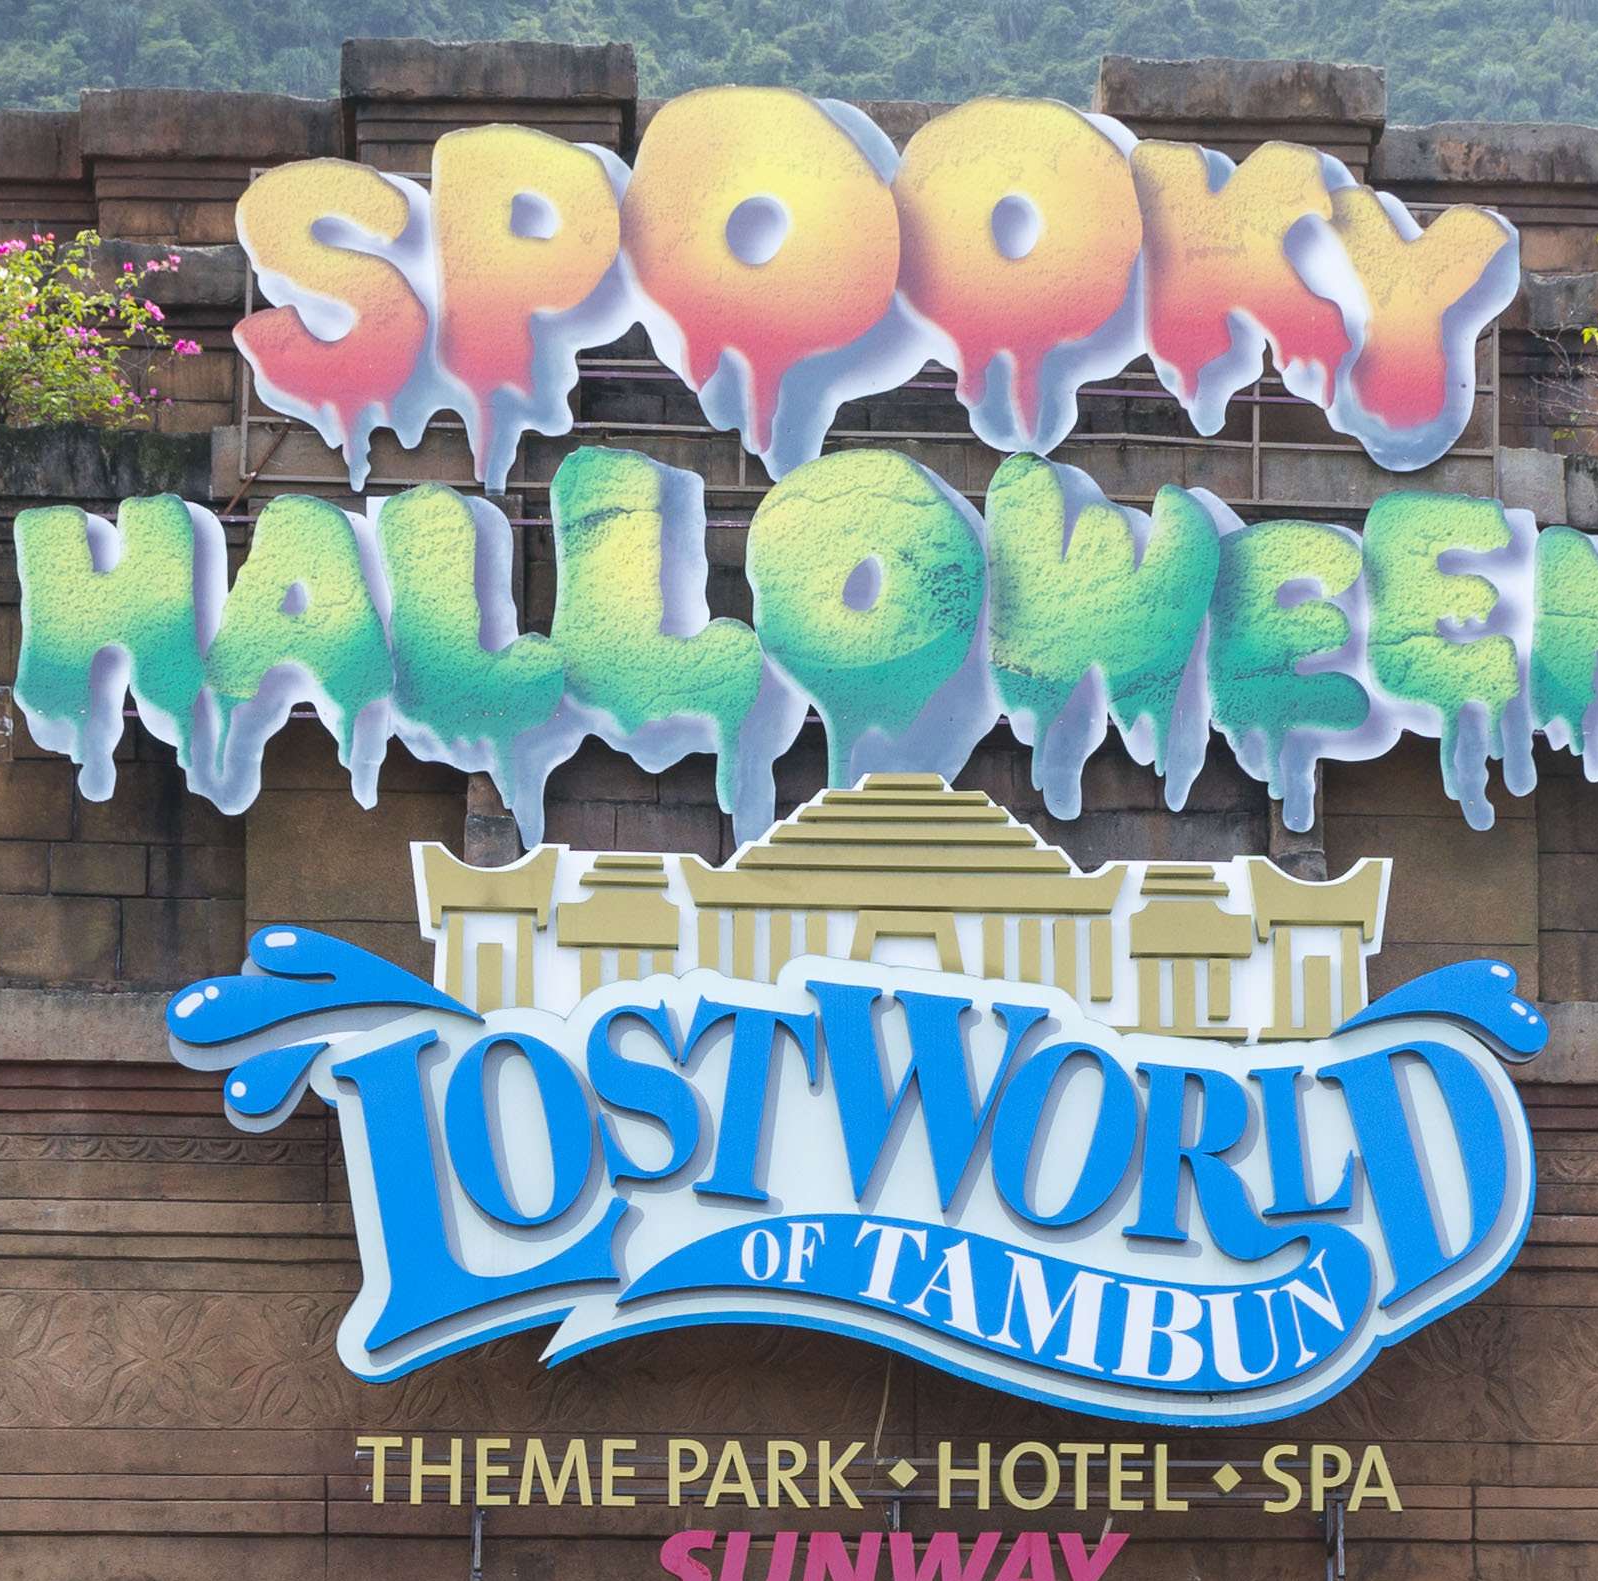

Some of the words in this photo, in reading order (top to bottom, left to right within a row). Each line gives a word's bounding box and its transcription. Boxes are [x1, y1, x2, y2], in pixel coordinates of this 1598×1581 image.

[233, 87, 1521, 492] SPOOKY
[742, 1219, 825, 1285] OF
[853, 1222, 1347, 1385] TAMBUN
[356, 1435, 637, 1508] THEME
[669, 1437, 865, 1510] PARK
[936, 1440, 1189, 1513] HOTEL
[1260, 1443, 1405, 1513] SPA
